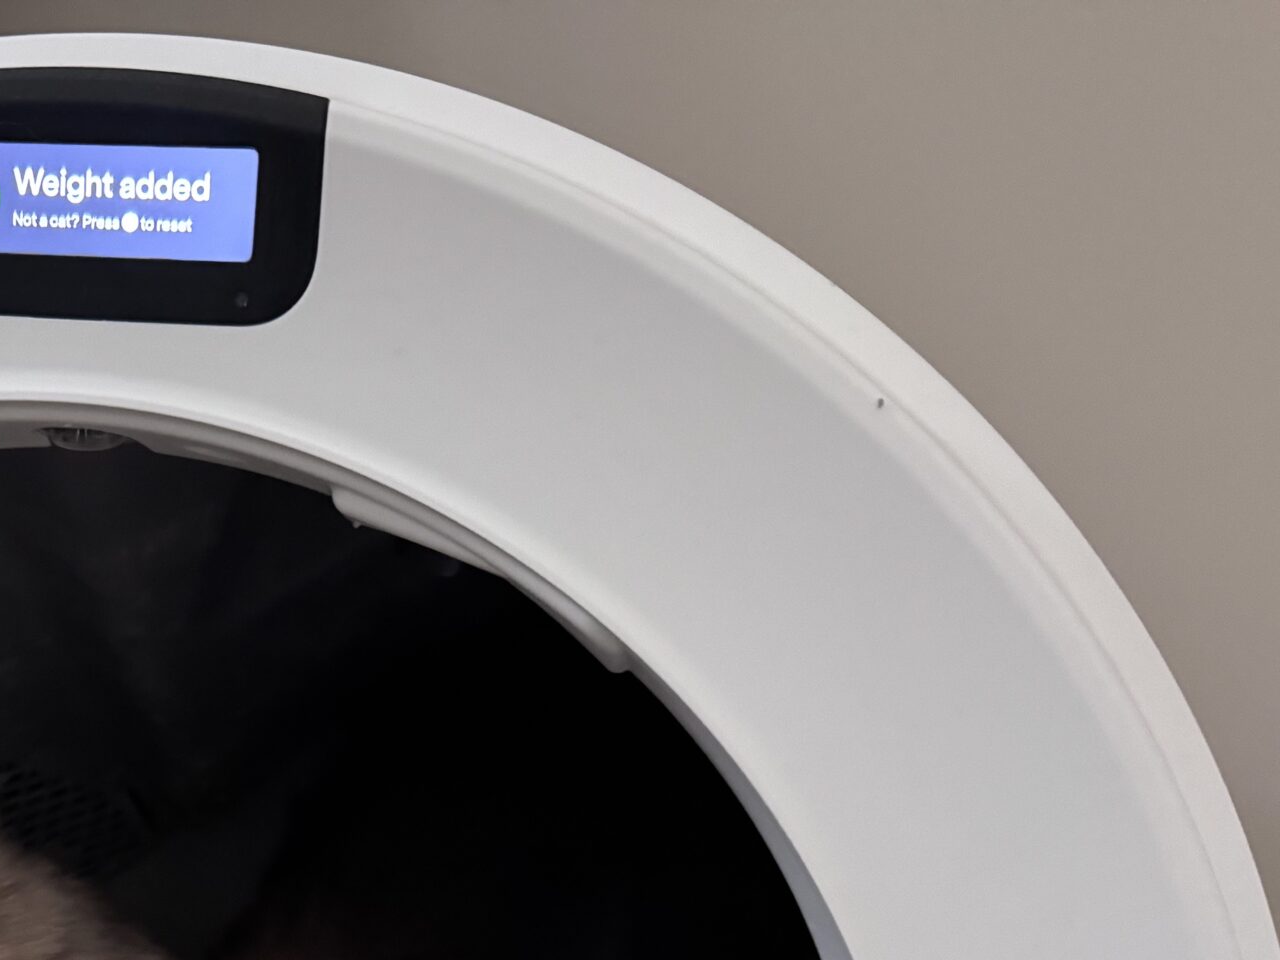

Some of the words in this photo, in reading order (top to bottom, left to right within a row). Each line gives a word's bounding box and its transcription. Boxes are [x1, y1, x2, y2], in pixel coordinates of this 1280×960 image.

[13, 166, 114, 204] Weight
[119, 169, 211, 202] added
[13, 209, 38, 228] Not
[39, 213, 48, 228] a
[49, 212, 80, 229] cat?
[82, 213, 120, 231] Press
[140, 215, 155, 232] to
[156, 216, 193, 233] reset
